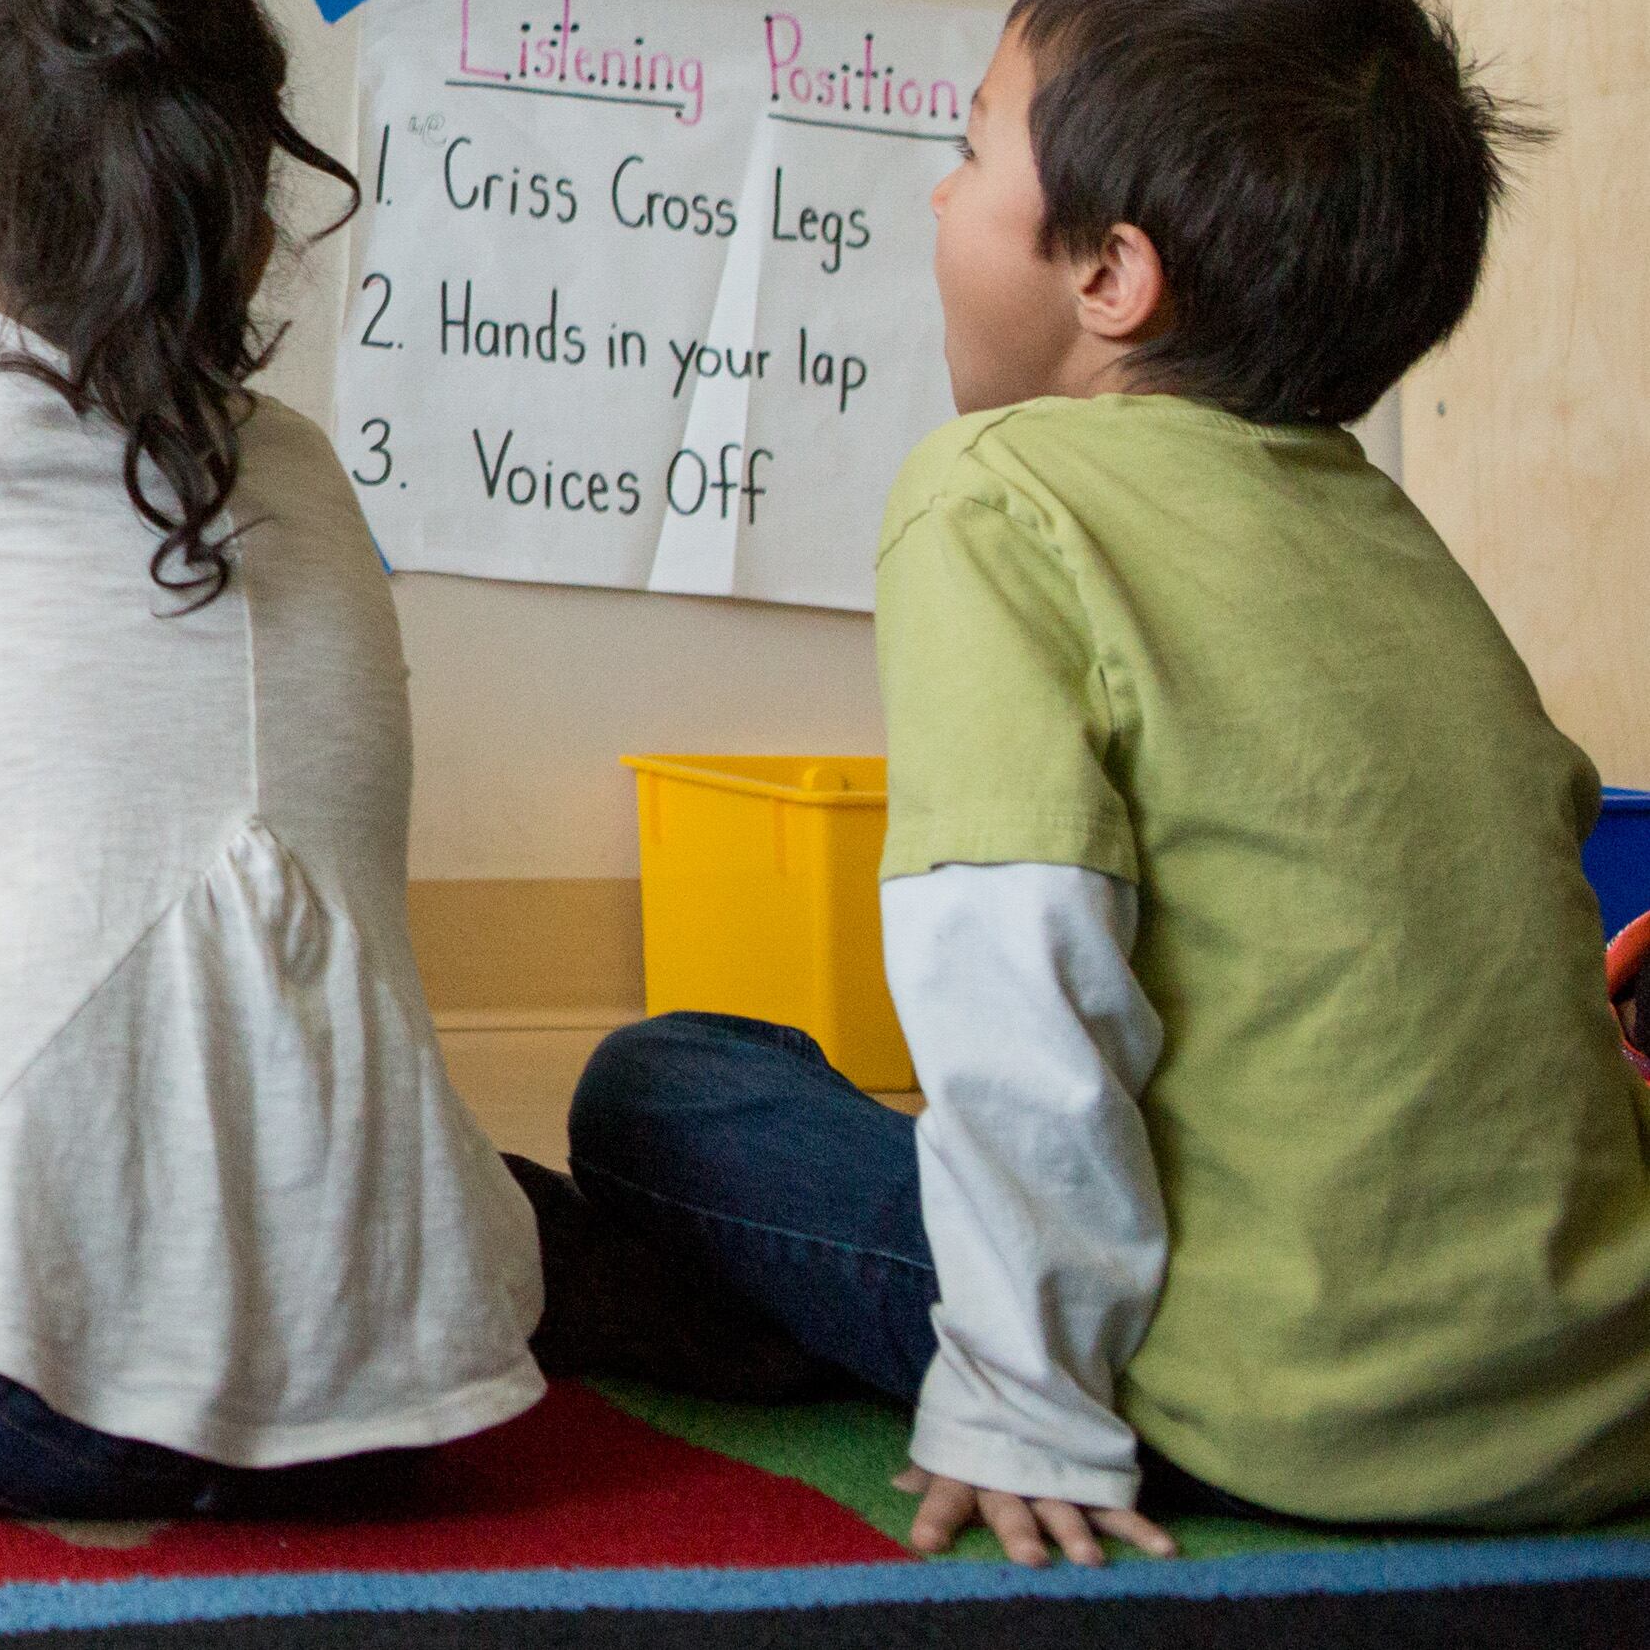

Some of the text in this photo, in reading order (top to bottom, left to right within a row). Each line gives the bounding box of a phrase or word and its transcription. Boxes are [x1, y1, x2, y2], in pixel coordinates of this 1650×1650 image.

[764, 12, 961, 121] Position
[443, 135, 579, 226] Criss
[610, 156, 739, 240] Cross
[771, 166, 872, 275] Legs
[360, 272, 869, 413] 2. Hands in your lap
[351, 417, 775, 526] 3. Voices Off
